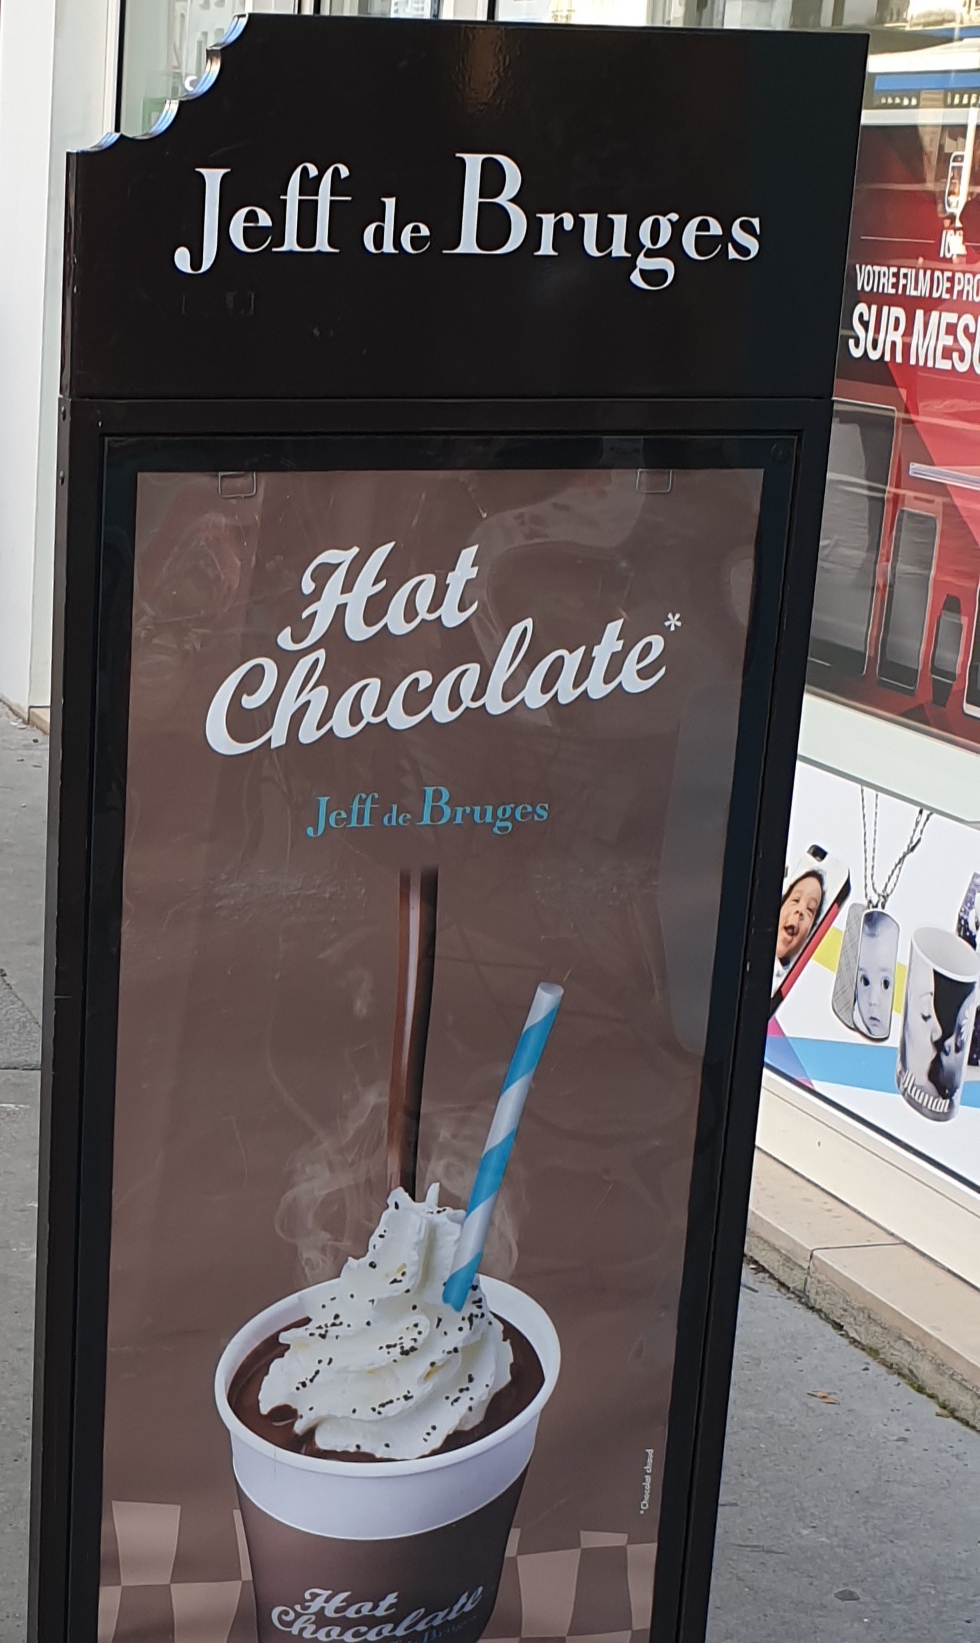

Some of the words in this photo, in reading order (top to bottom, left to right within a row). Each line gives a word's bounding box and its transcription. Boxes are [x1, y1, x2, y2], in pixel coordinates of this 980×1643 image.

[174, 162, 352, 275] Jeff
[363, 197, 431, 255] de
[442, 152, 761, 291] Bruges
[855, 263, 898, 294] VOTRE
[898, 267, 931, 298] FILM
[932, 270, 953, 300] DE
[848, 302, 906, 364] SUR
[277, 541, 480, 652] Hot
[306, 792, 380, 838] Jeff
[382, 798, 412, 828] de
[417, 786, 550, 835] Bruges
[294, 1587, 400, 1618] Hot
